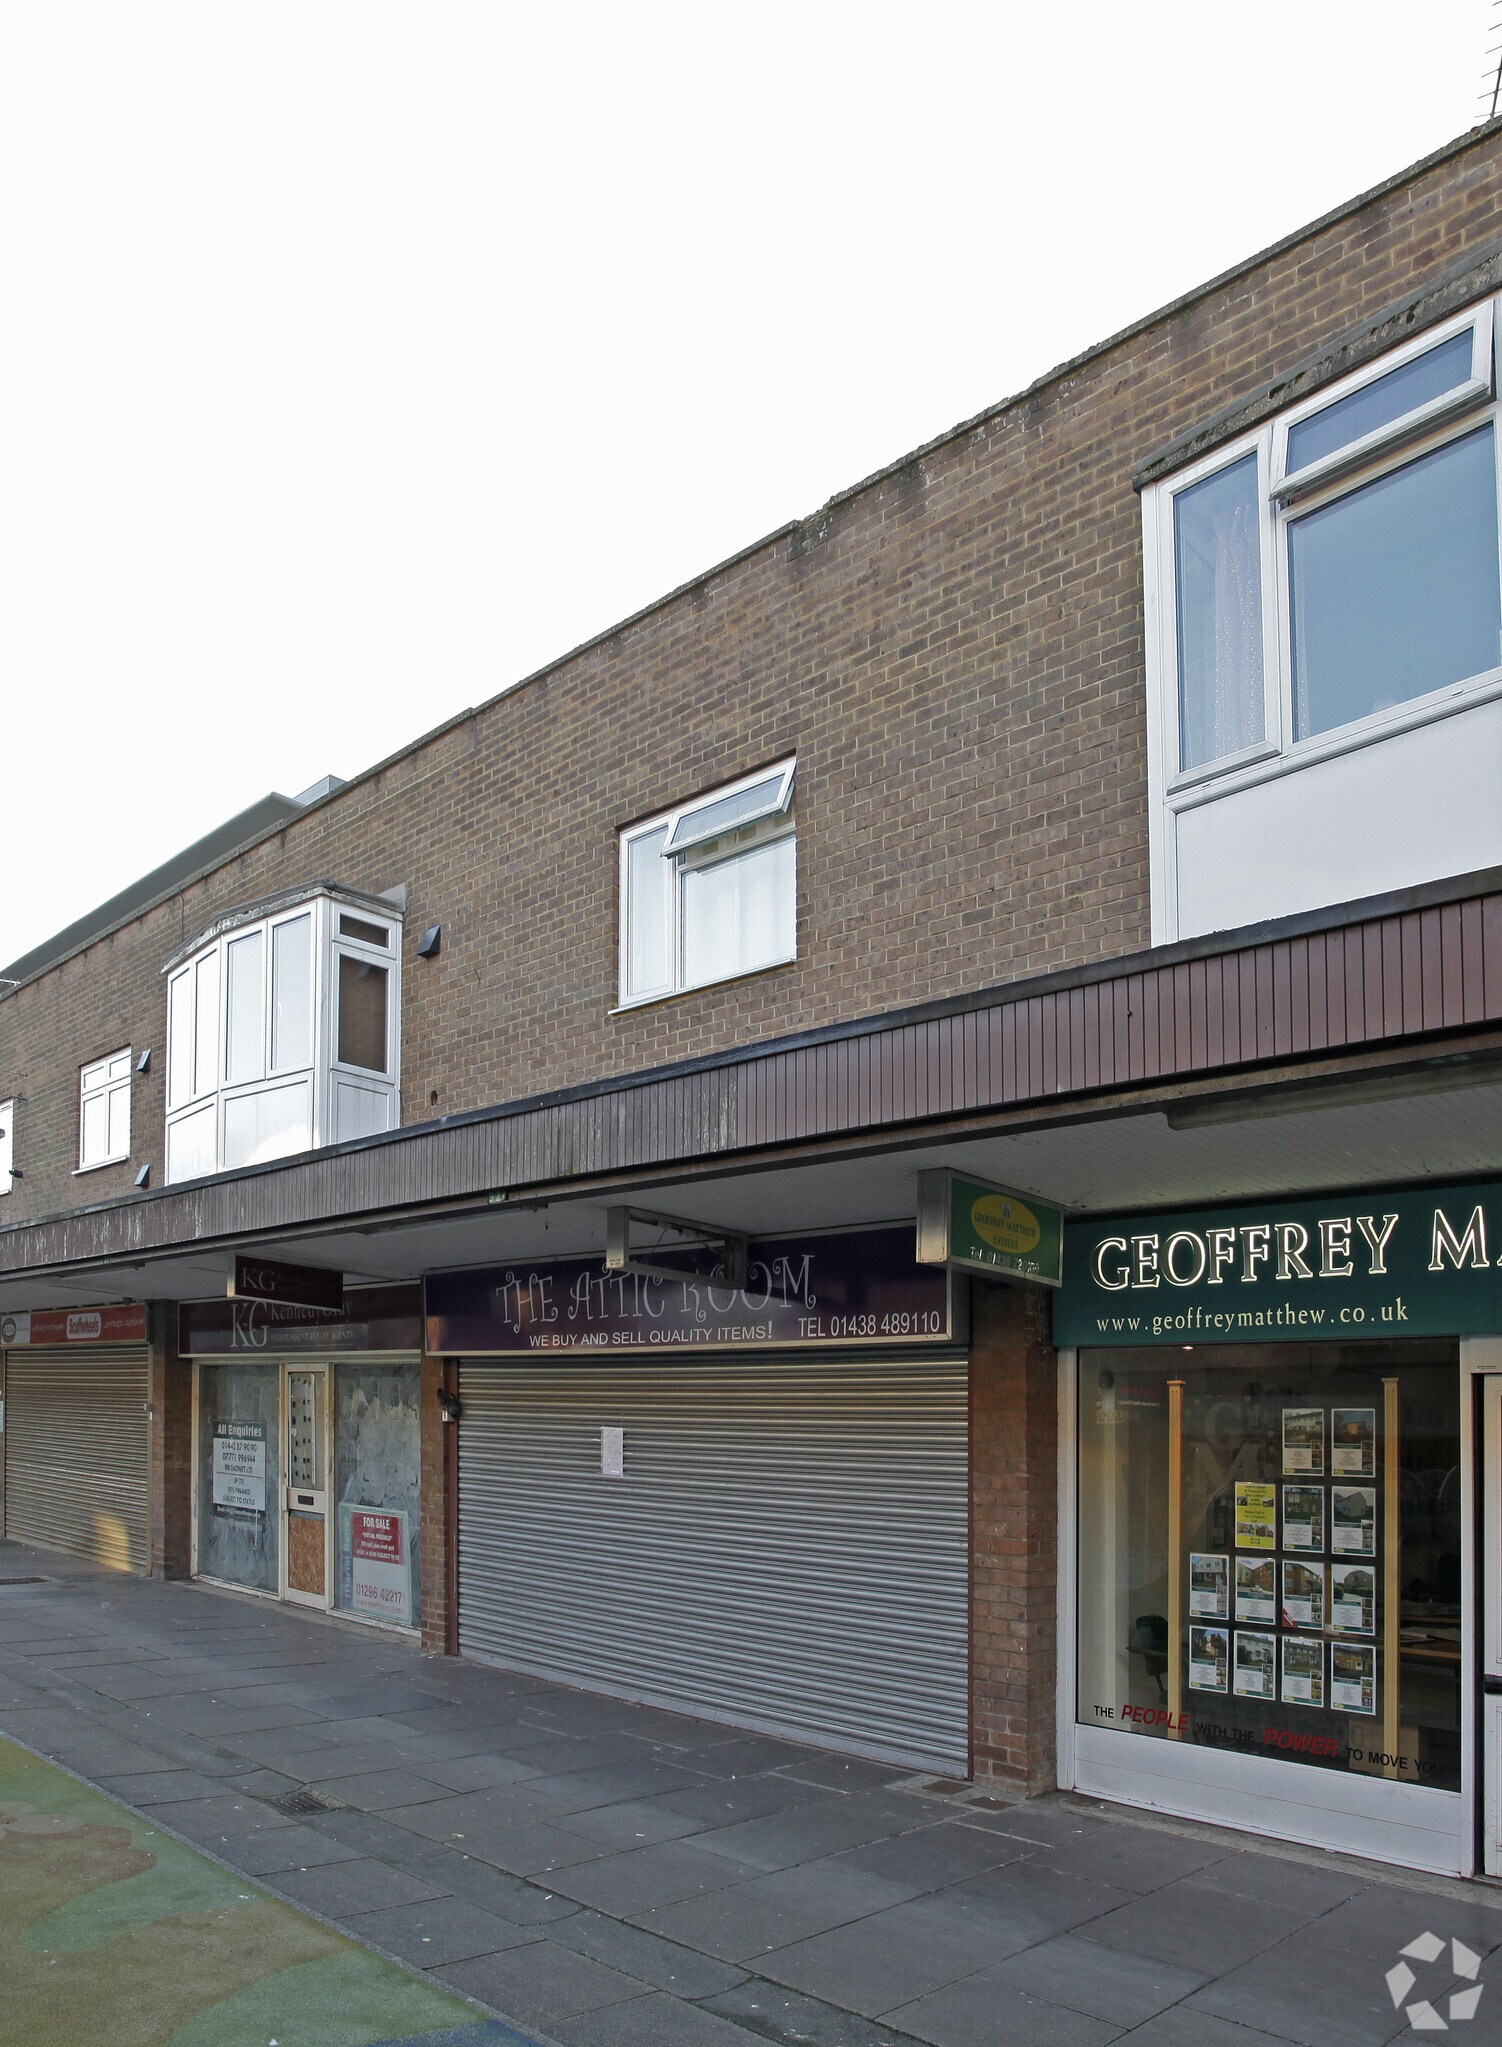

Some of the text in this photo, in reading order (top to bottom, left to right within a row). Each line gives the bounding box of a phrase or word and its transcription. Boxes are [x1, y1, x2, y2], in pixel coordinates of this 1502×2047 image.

[974, 1212, 1036, 1238] GEOFFREY MATTHEW
[993, 1234, 1018, 1249] ESTATES
[1090, 1205, 1502, 1291] GEOFFREY M
[242, 1266, 277, 1291] KG
[496, 1254, 817, 1333] THE ATTIC ROOM
[230, 1300, 270, 1347] KG
[798, 1311, 940, 1337] TEL 01438 489110
[1096, 1298, 1409, 1335] www.geoffreymatthew.co.uk
[270, 1332, 308, 1343] INDEPENDENT
[331, 1330, 354, 1341] AGENTS
[529, 1321, 773, 1347] WE BUY AND SELL QUALITY ITEMS!
[217, 1424, 262, 1437] All Enquiries
[237, 1496, 242, 1504] TO
[363, 1516, 390, 1530] FOR SALE
[356, 1583, 378, 1599] 01296
[1093, 1705, 1115, 1720] THE
[1120, 1703, 1192, 1732] PEOPLE
[1196, 1722, 1227, 1737] WITH
[1231, 1728, 1255, 1742] THE
[1262, 1727, 1339, 1758] POWER
[1344, 1747, 1363, 1761] TO
[1368, 1751, 1408, 1770] MOVE
